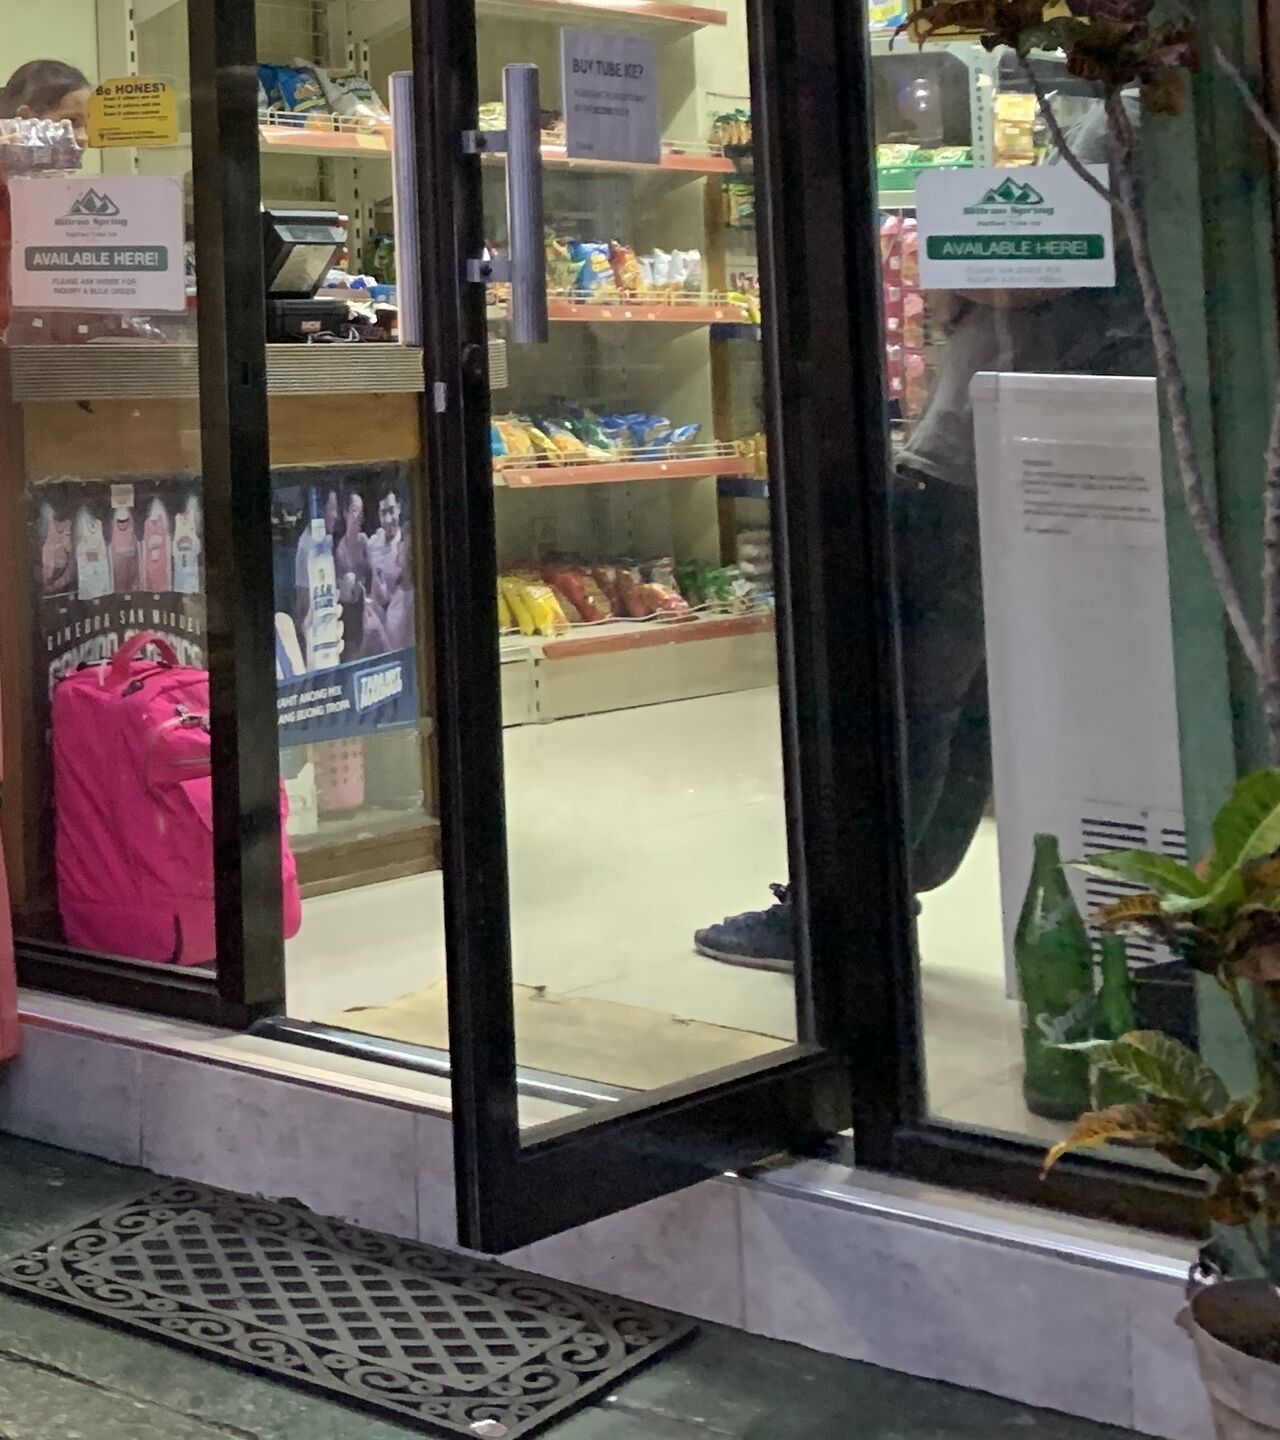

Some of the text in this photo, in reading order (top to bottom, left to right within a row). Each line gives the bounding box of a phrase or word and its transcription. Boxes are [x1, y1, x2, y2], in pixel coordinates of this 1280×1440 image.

[572, 58, 593, 74] BUY
[596, 60, 622, 77] TUBE
[942, 240, 1088, 256] AVAILABLE HERE!
[33, 250, 159, 267] AVAILABLE HERE!
[119, 608, 145, 625] SAN
